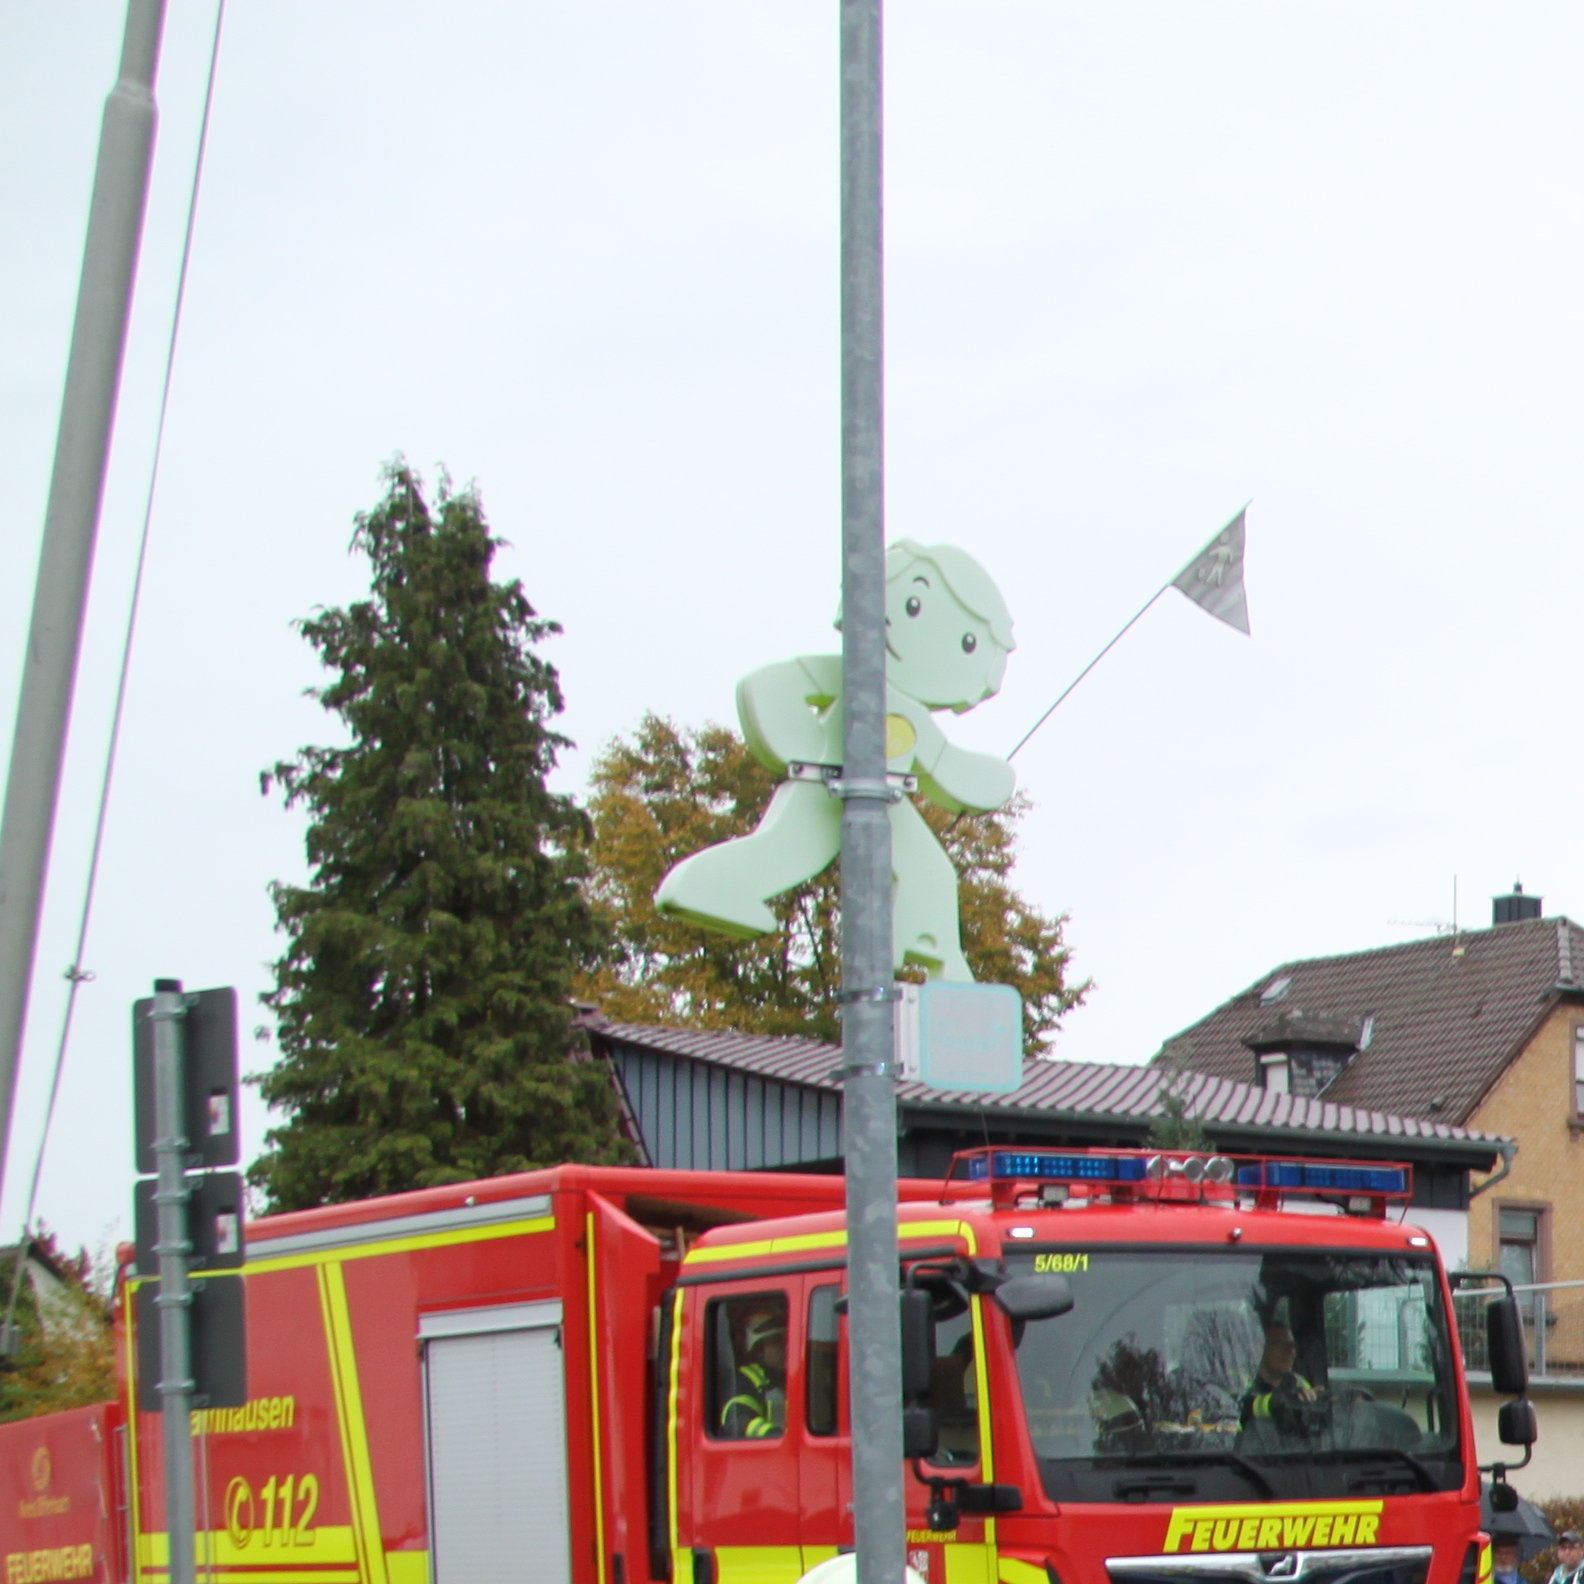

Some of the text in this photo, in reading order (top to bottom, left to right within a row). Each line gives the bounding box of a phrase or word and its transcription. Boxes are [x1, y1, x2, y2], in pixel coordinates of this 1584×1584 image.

[1034, 1253, 1089, 1273] 5/68/1
[189, 1395, 295, 1437] ainhausen
[260, 1473, 318, 1548] 112
[1162, 1500, 1384, 1553] FEUERWEHR
